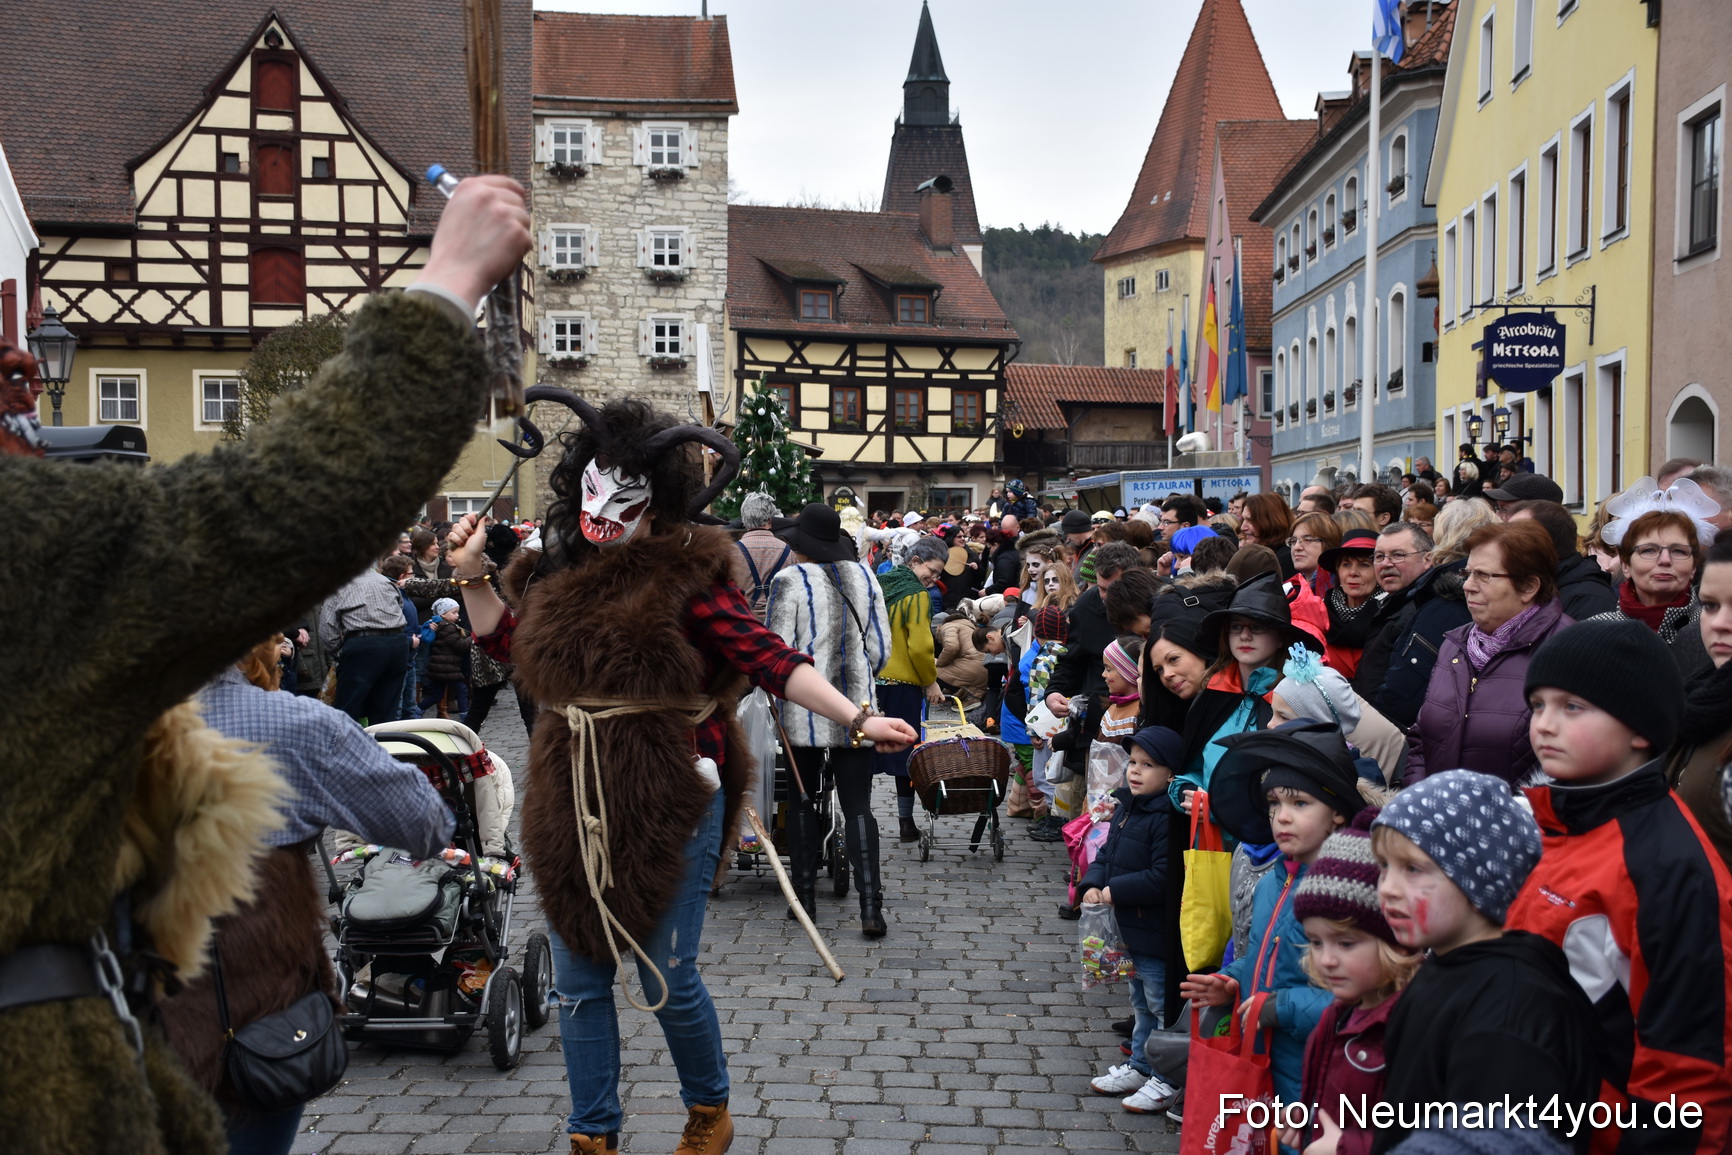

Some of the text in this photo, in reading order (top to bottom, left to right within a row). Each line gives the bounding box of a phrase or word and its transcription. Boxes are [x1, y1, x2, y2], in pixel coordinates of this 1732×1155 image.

[1497, 322, 1556, 339] Arcobräu
[1492, 342, 1560, 357] METEORA
[1211, 478, 1251, 488] METEORA
